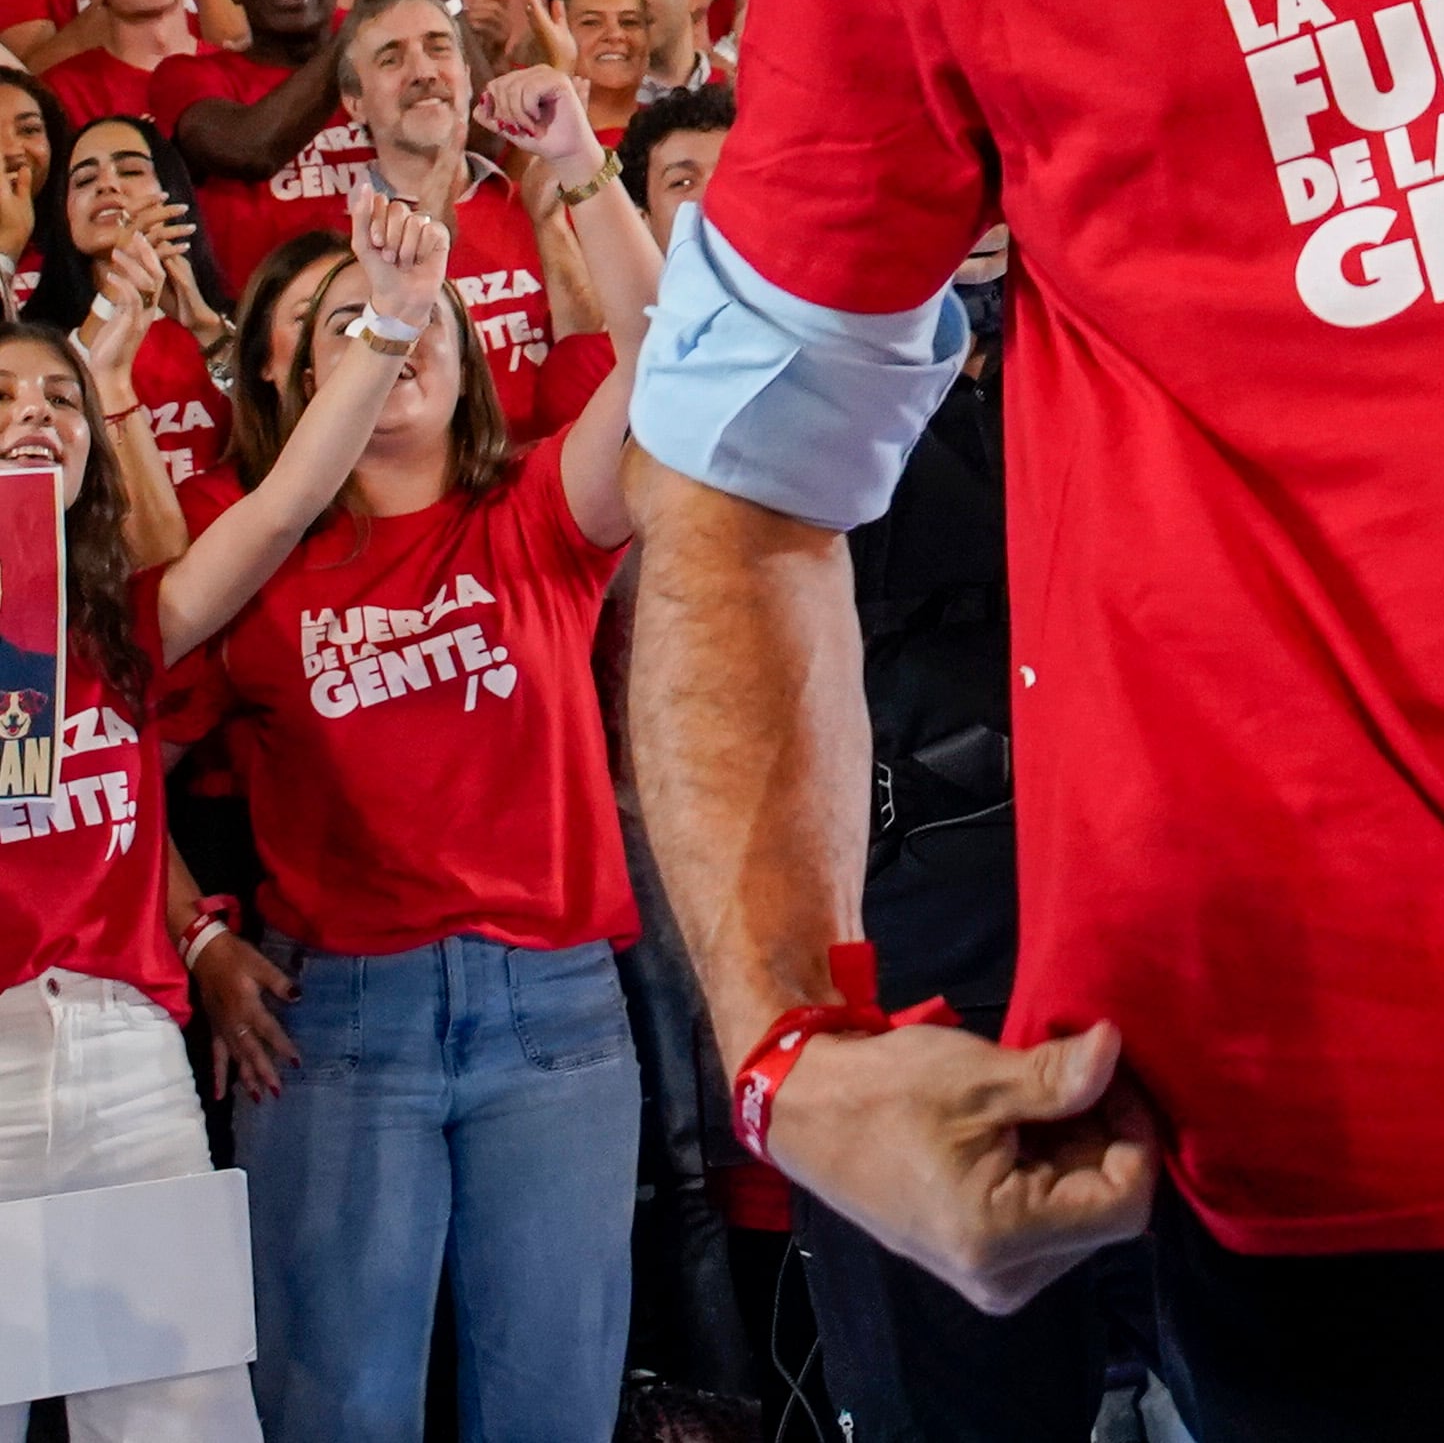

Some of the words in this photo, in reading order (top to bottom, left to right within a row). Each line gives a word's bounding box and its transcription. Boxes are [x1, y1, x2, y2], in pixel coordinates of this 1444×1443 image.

[1276, 138, 1381, 226] DE
[454, 269, 542, 307] RZA
[301, 608, 341, 627] LA
[302, 574, 497, 657] FUERZA
[303, 647, 340, 679] DE
[342, 643, 382, 665] LA
[310, 623, 508, 719] GENTE.
[0, 770, 137, 844] ENTE.
